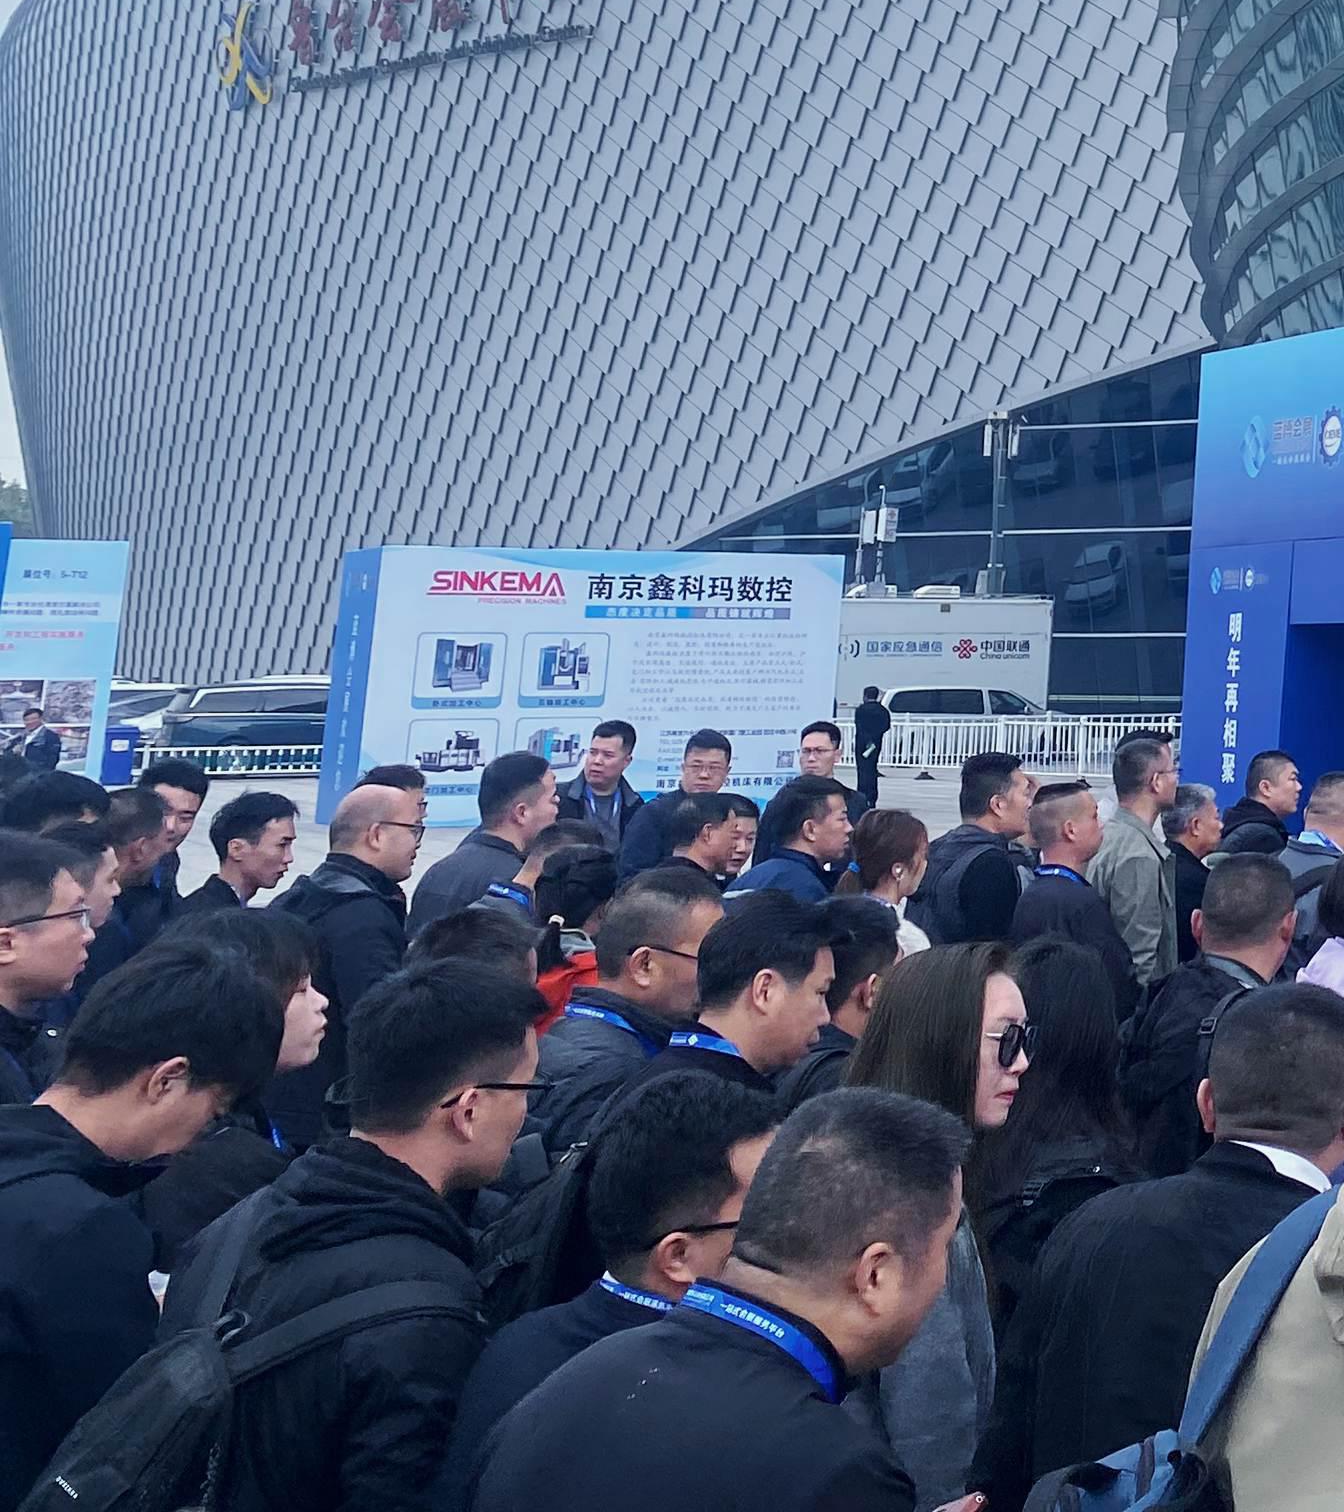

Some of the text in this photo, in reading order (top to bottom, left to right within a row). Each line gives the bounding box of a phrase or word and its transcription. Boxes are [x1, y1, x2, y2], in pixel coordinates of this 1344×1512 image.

[429, 570, 566, 597] SINKEMA
[587, 572, 794, 603] 南京鑫科玛数控
[866, 640, 943, 653] 国家应急通信
[980, 639, 1030, 653] 中国联通
[1220, 611, 1244, 785] 明年再相聚
